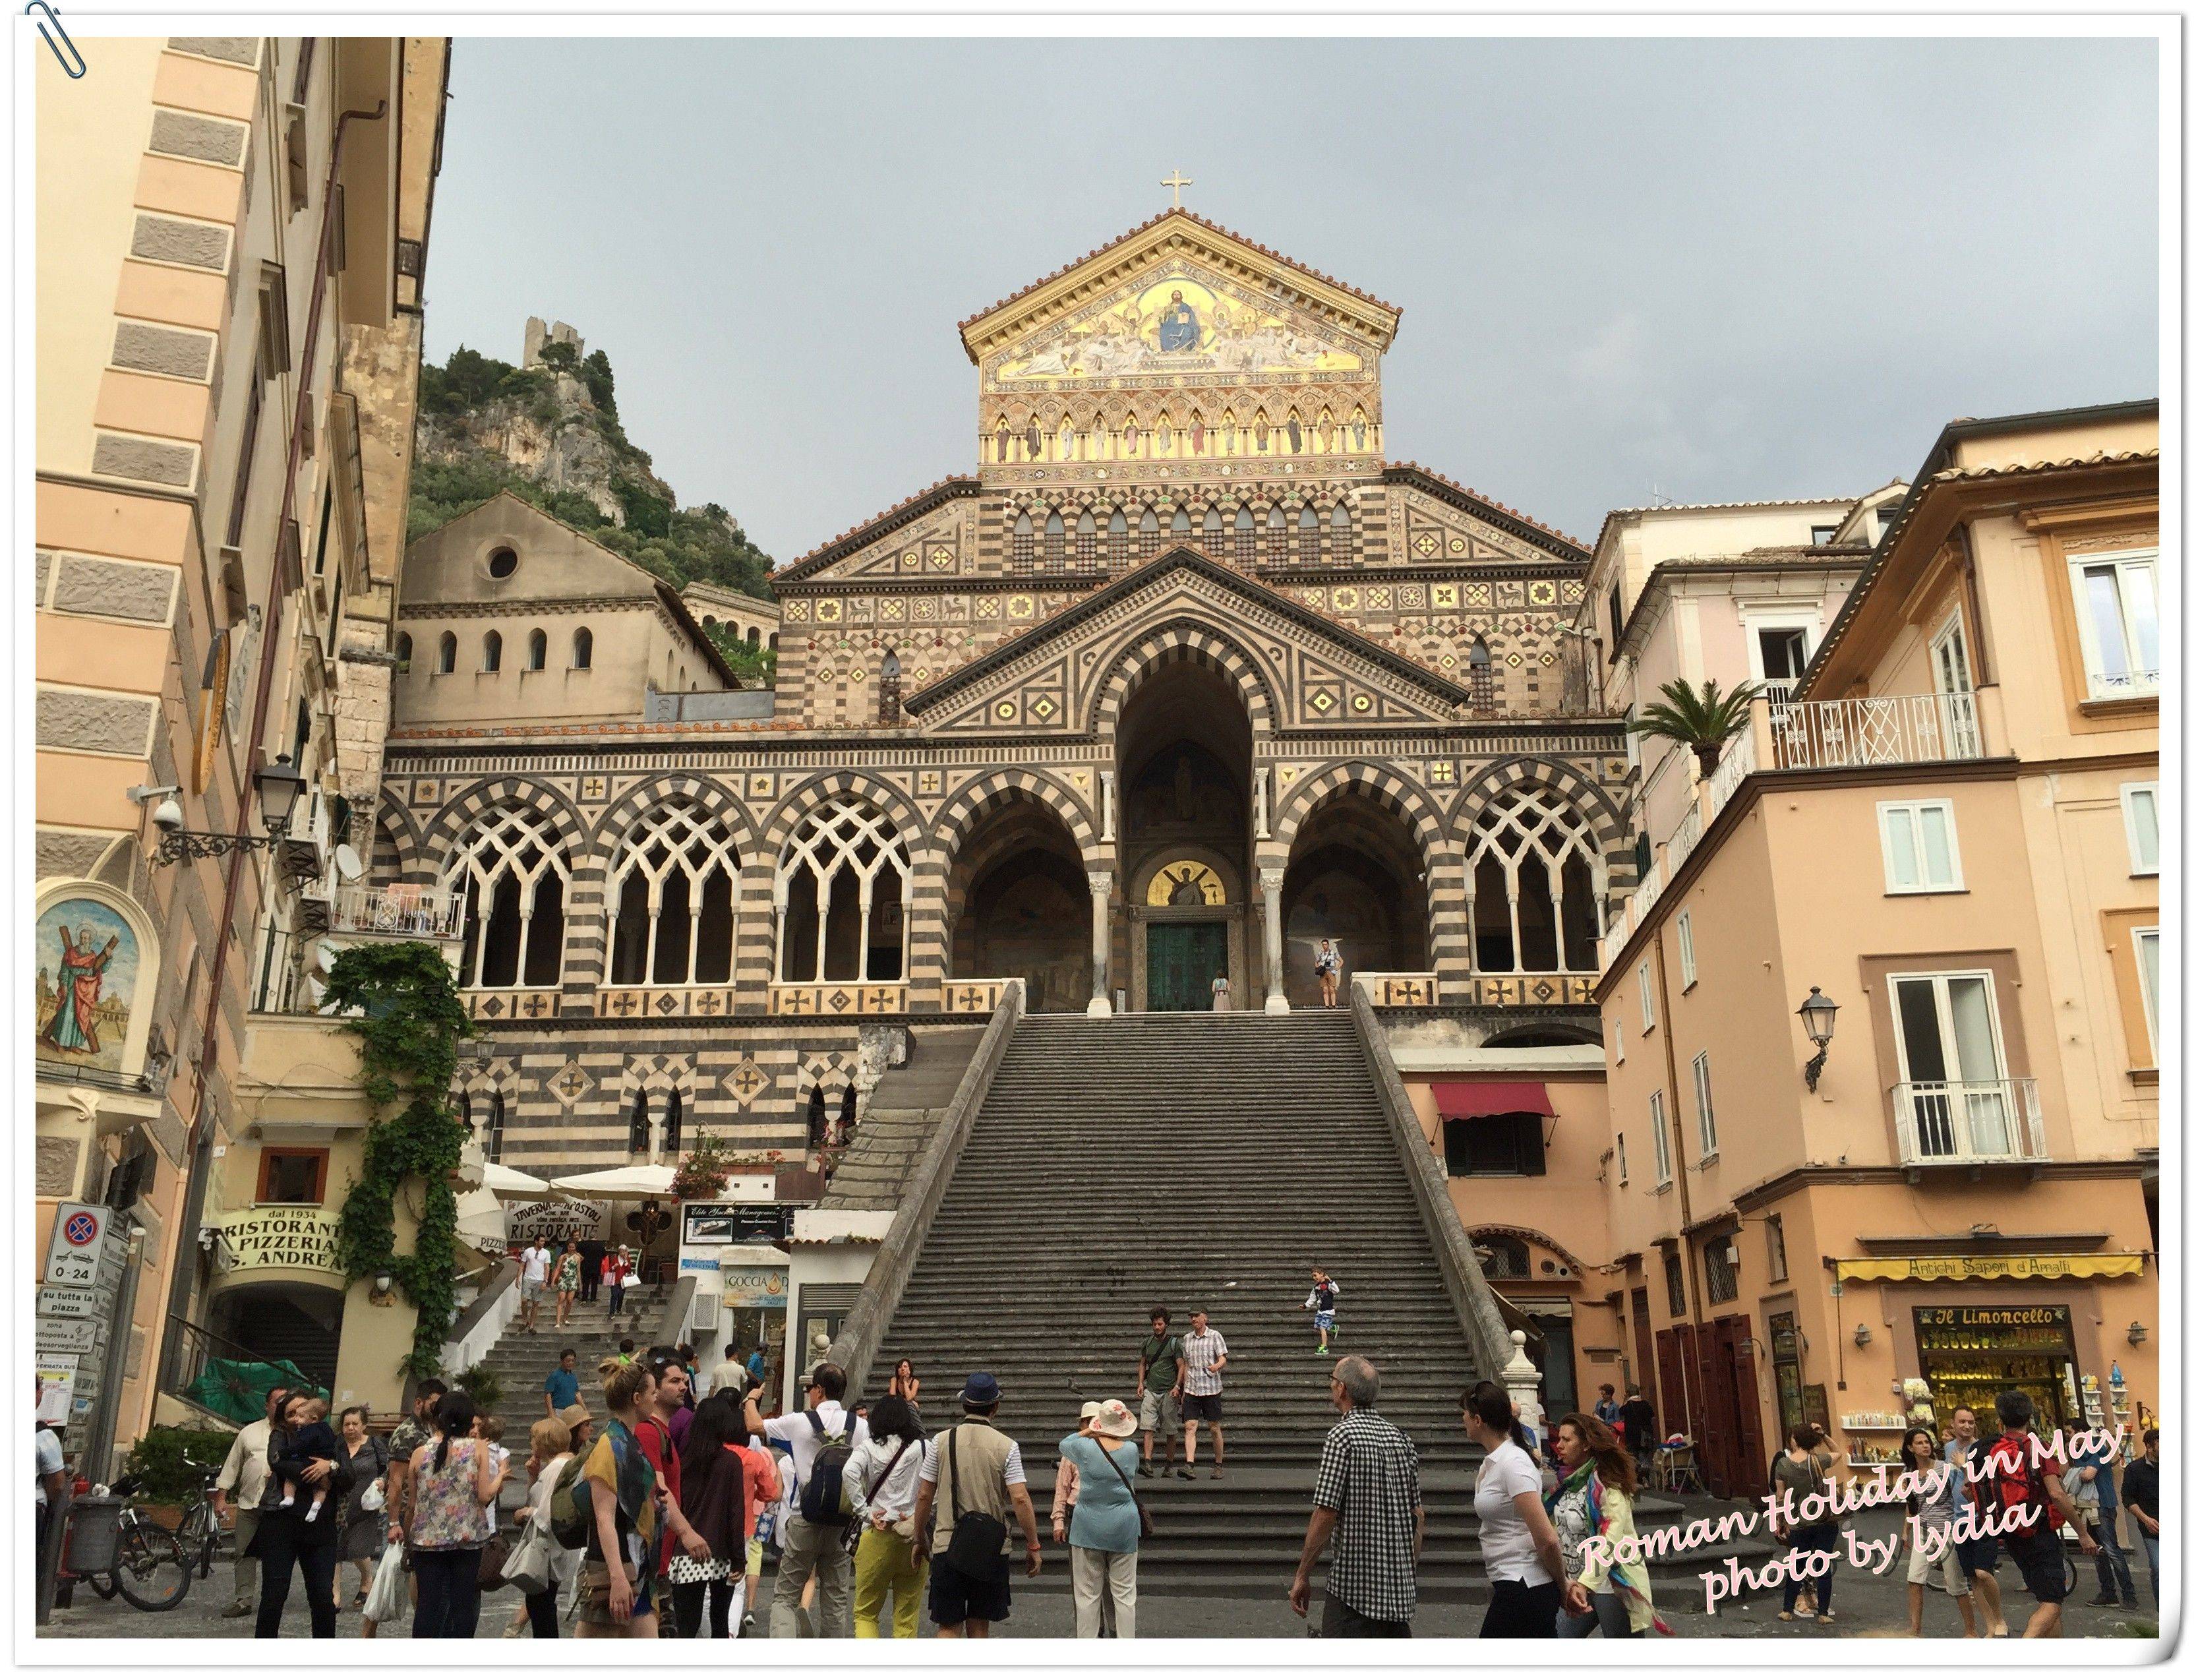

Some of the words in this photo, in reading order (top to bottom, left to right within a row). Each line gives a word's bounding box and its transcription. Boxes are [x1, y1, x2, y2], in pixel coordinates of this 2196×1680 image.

[291, 1211, 316, 1219] 1934
[514, 1202, 551, 1221] TAVERNA
[225, 1220, 343, 1238] RISTORANT
[239, 1236, 335, 1253] PIZZERIA
[256, 1251, 342, 1271] ANDREA
[1910, 1259, 1955, 1274] Antichi
[1962, 1259, 2009, 1275] Sapori
[728, 1276, 768, 1286] GOCCIA
[57, 1292, 80, 1301] tutta
[1936, 1309, 1955, 1324] Il
